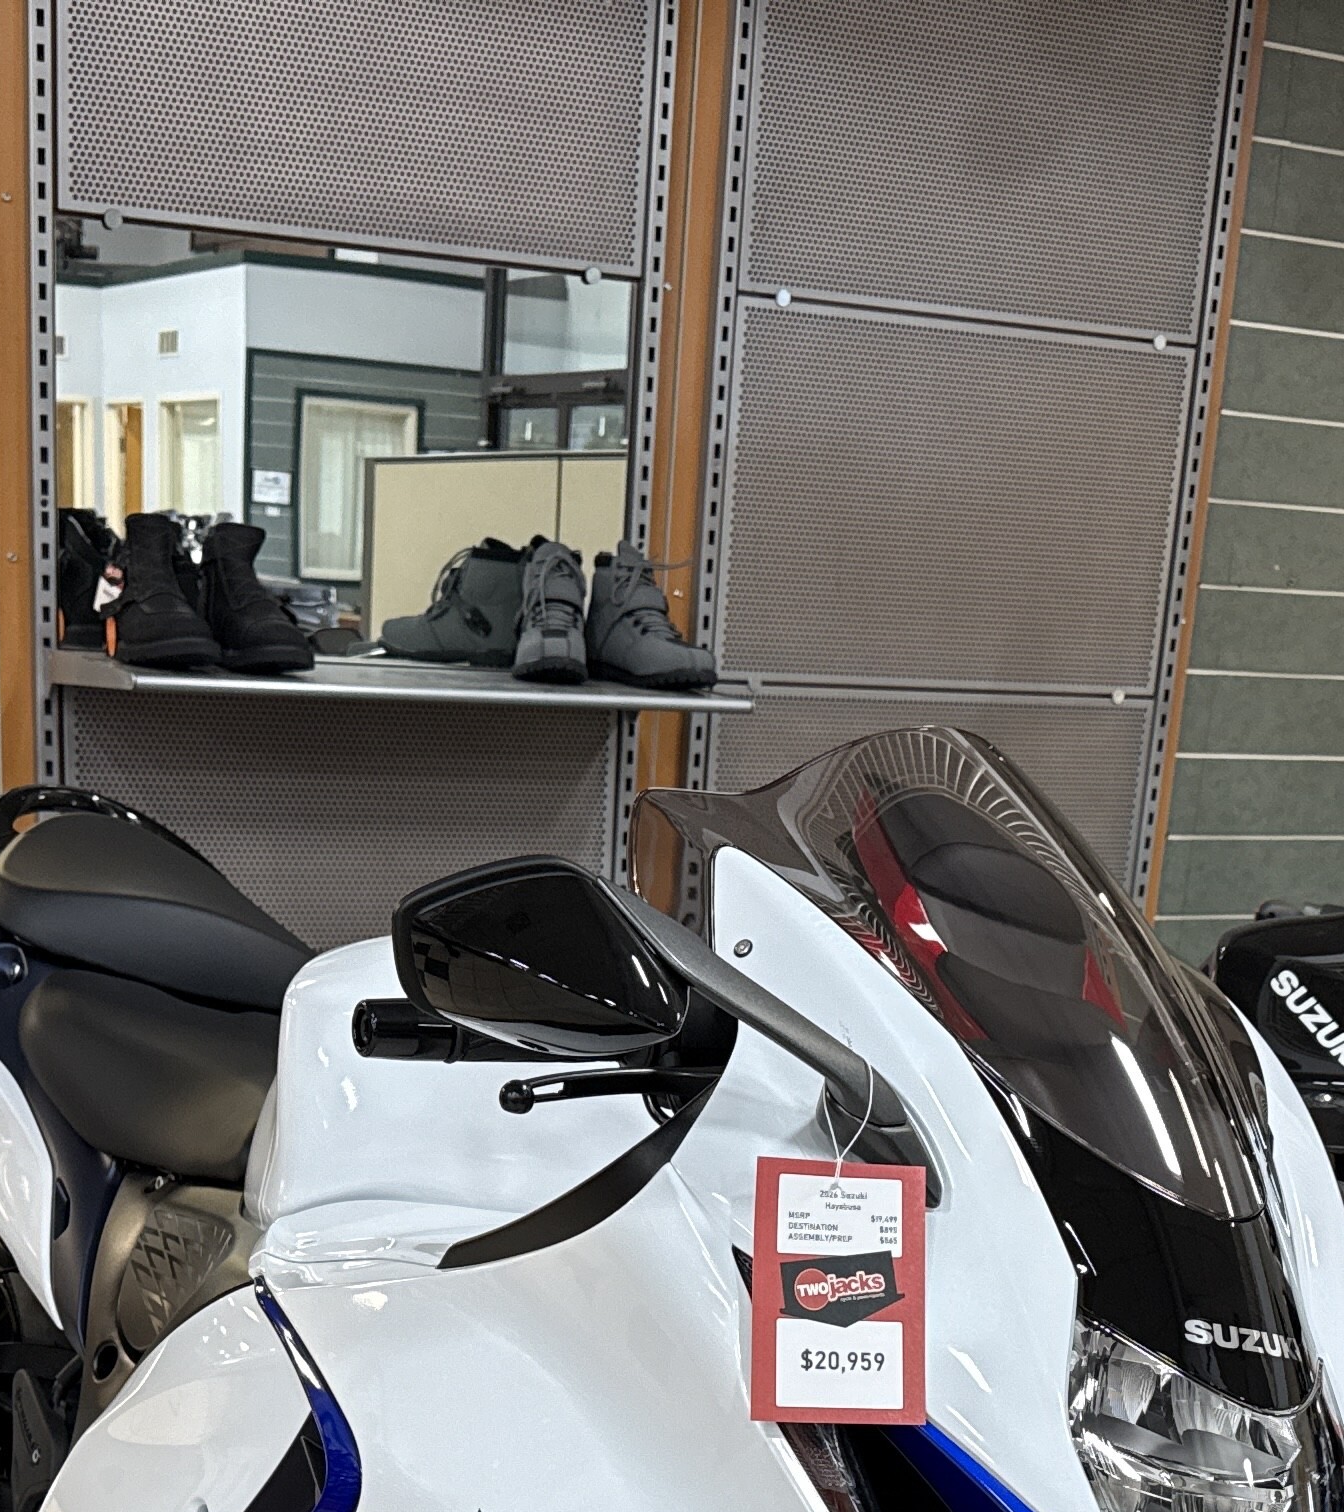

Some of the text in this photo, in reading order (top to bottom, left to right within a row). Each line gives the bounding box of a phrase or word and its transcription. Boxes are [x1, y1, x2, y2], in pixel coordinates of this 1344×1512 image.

[841, 1191, 868, 1200] Suzuki
[788, 1211, 810, 1219] MSRP
[788, 1222, 838, 1231] DESTINATION
[788, 1233, 853, 1243] ASSEMBLY/PREP
[801, 1348, 885, 1374] $20,959
